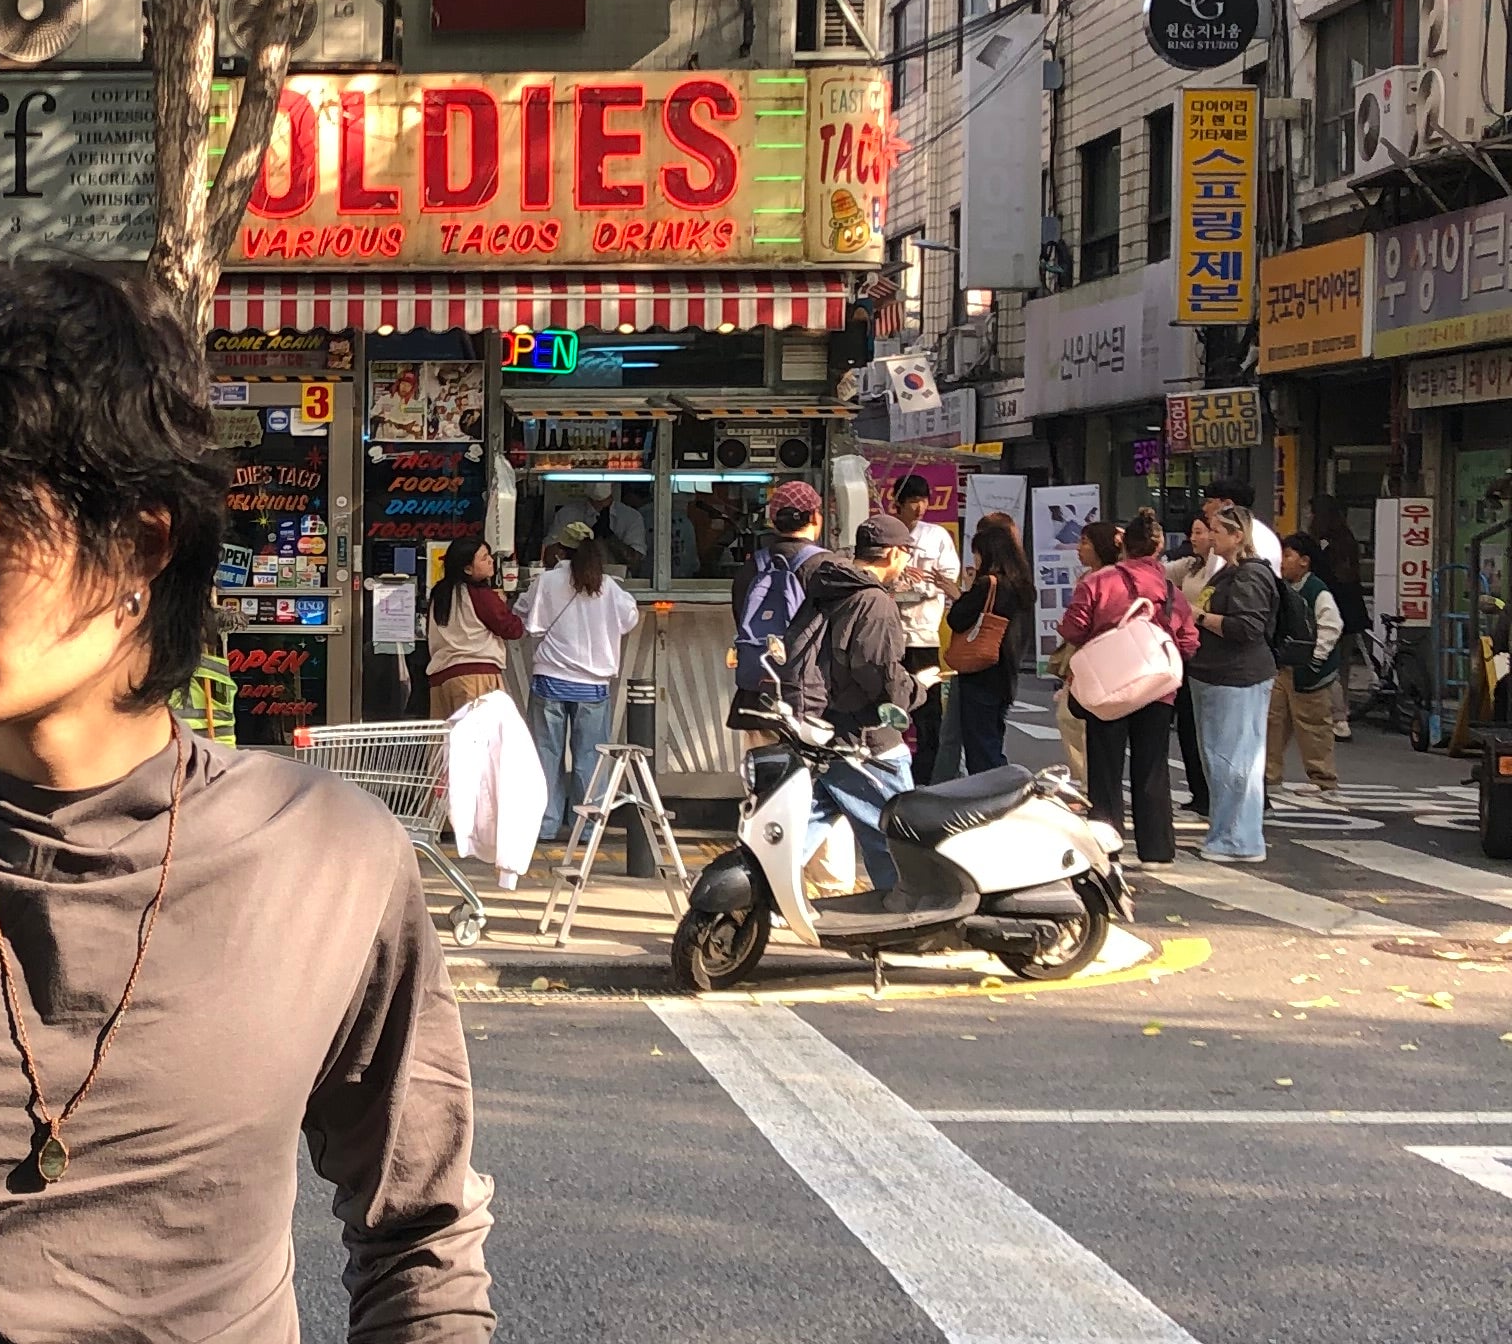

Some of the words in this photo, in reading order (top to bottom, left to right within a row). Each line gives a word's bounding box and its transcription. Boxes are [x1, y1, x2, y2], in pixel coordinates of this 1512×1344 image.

[334, 3, 355, 19] LG
[1168, 41, 1195, 50] RING
[1197, 41, 1239, 50] STUDIO
[830, 88, 865, 114] EAST
[1191, 100, 1248, 113] 다이어리
[72, 110, 155, 124] ESPRESSO
[65, 152, 156, 166] APERITIVO
[247, 80, 741, 219] OLDIES
[69, 172, 155, 186] ICECREAM
[81, 193, 156, 207] WHISKEY
[242, 221, 407, 259] VARIOUS
[440, 218, 562, 256] TACOS
[592, 217, 739, 255] DRINKS
[1378, 211, 1512, 317] 우성아크
[214, 335, 263, 351] COME
[266, 335, 325, 351] AGAIN
[1061, 324, 1126, 380] 신우시스템
[306, 386, 330, 420] 3
[1192, 420, 1259, 447] 다이어리
[230, 465, 273, 488] LDIES
[276, 465, 321, 490] TACO
[387, 476, 465, 493] FOODS
[384, 498, 470, 516] DRINKS
[1401, 505, 1432, 547] 우성
[224, 548, 250, 568] PEN
[256, 575, 276, 585] VISA
[1400, 559, 1433, 621] 아크릴
[227, 648, 310, 674] OPEN
